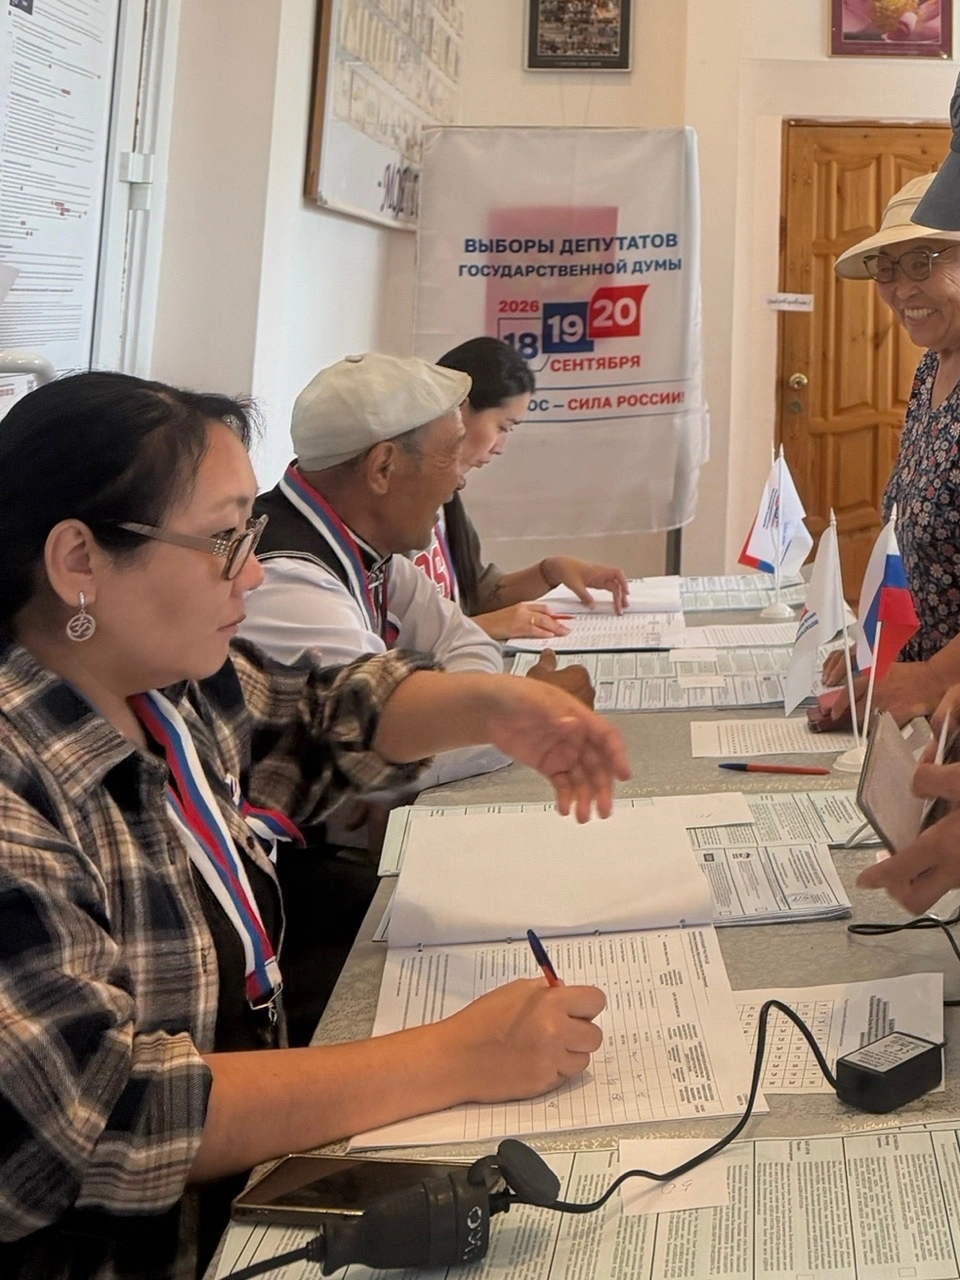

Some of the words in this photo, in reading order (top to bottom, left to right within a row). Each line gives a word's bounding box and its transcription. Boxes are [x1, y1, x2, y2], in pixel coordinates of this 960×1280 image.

[464, 238, 554, 254] ВЫБОРЫ
[559, 233, 679, 256] ДЕПУТАТОВ
[458, 259, 628, 279] ГОСУДАРСТВЕННОЙ
[631, 258, 682, 275] ДУМЫ
[498, 300, 540, 313] 2026
[503, 332, 539, 360] 18
[547, 314, 585, 344] 19
[592, 297, 638, 328] 20
[550, 355, 641, 372] СЕНТЯБРЯ
[567, 396, 612, 411] СИЛА
[616, 391, 685, 408] РОССИИ!
